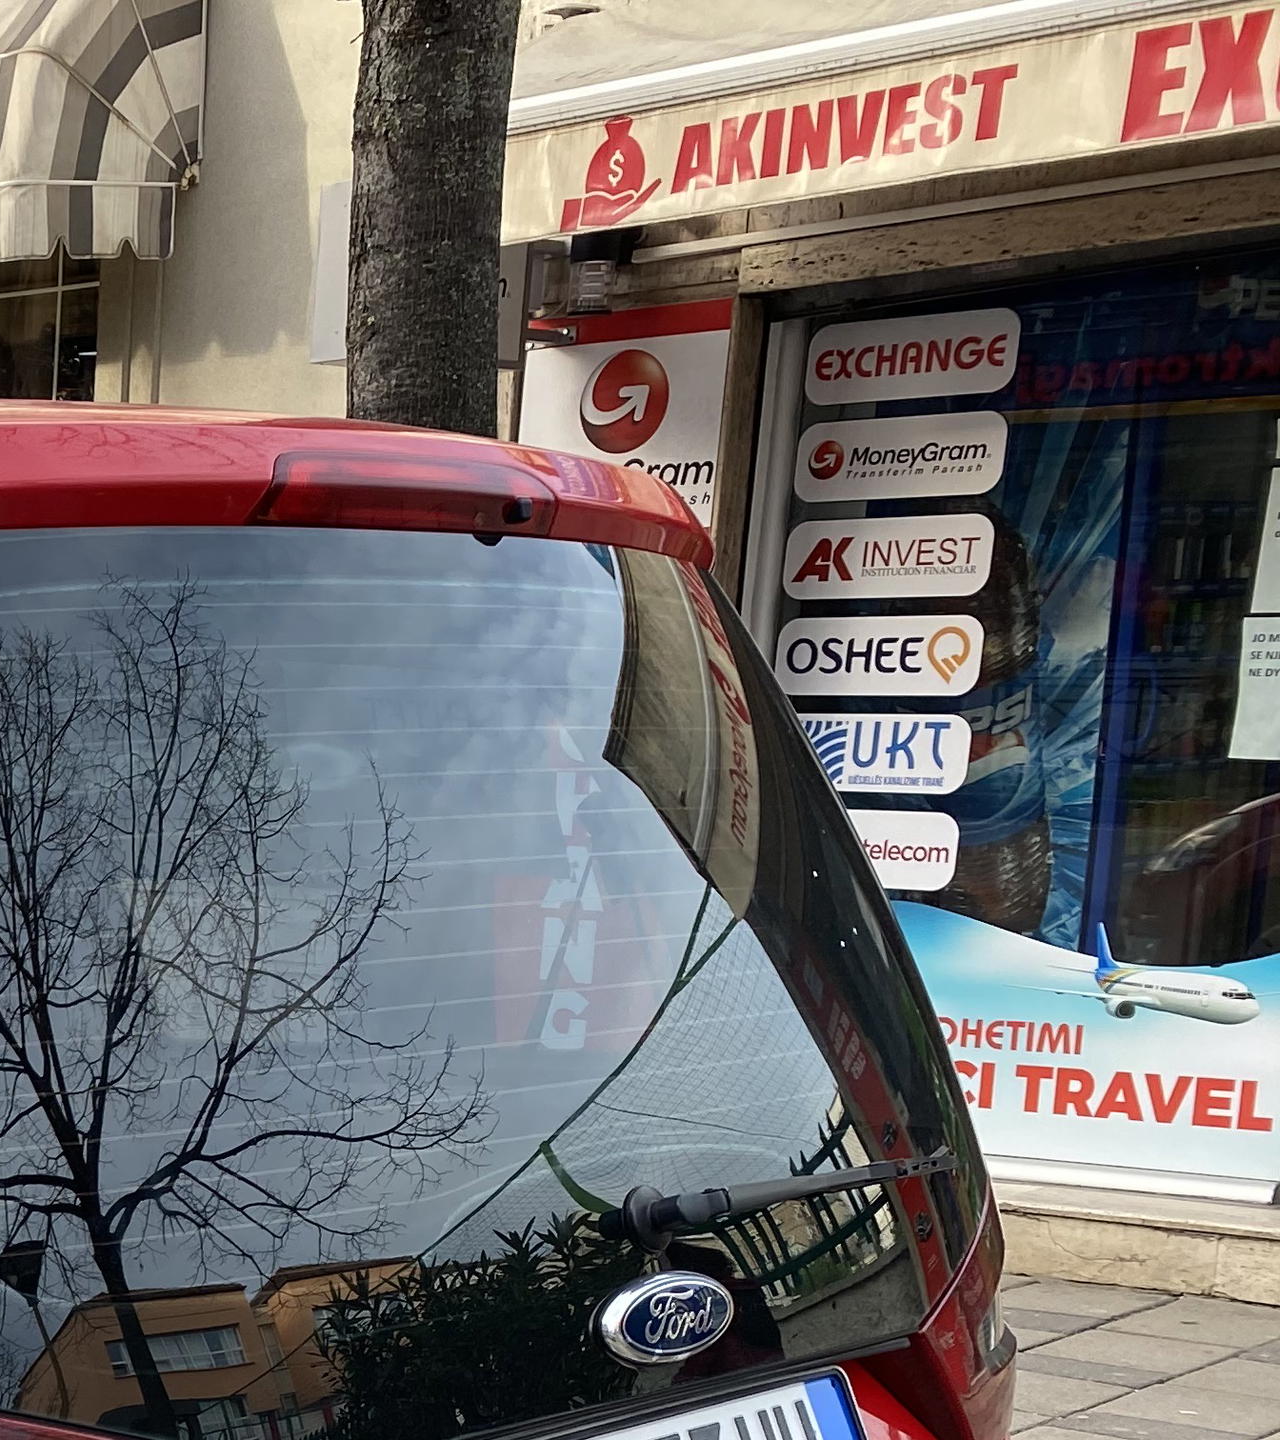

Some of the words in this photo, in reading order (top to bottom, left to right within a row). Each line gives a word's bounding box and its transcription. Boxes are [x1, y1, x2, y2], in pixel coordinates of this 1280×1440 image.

[1120, 9, 1280, 144] EX
[670, 64, 1018, 194] AKINVEST
[815, 333, 1009, 381] EXCHANGE
[845, 466, 924, 479] Transferim
[932, 464, 983, 475] Parash
[849, 442, 988, 468] MoneyGram
[791, 536, 856, 582] AK
[862, 537, 982, 568] INVEST
[923, 565, 977, 576] FINANCIAR
[786, 637, 925, 674] OSHEE
[1250, 651, 1262, 660] SE
[852, 720, 952, 769] UKT
[1015, 1063, 1274, 1132] TRAVEL
[644, 1291, 713, 1345] Ford
